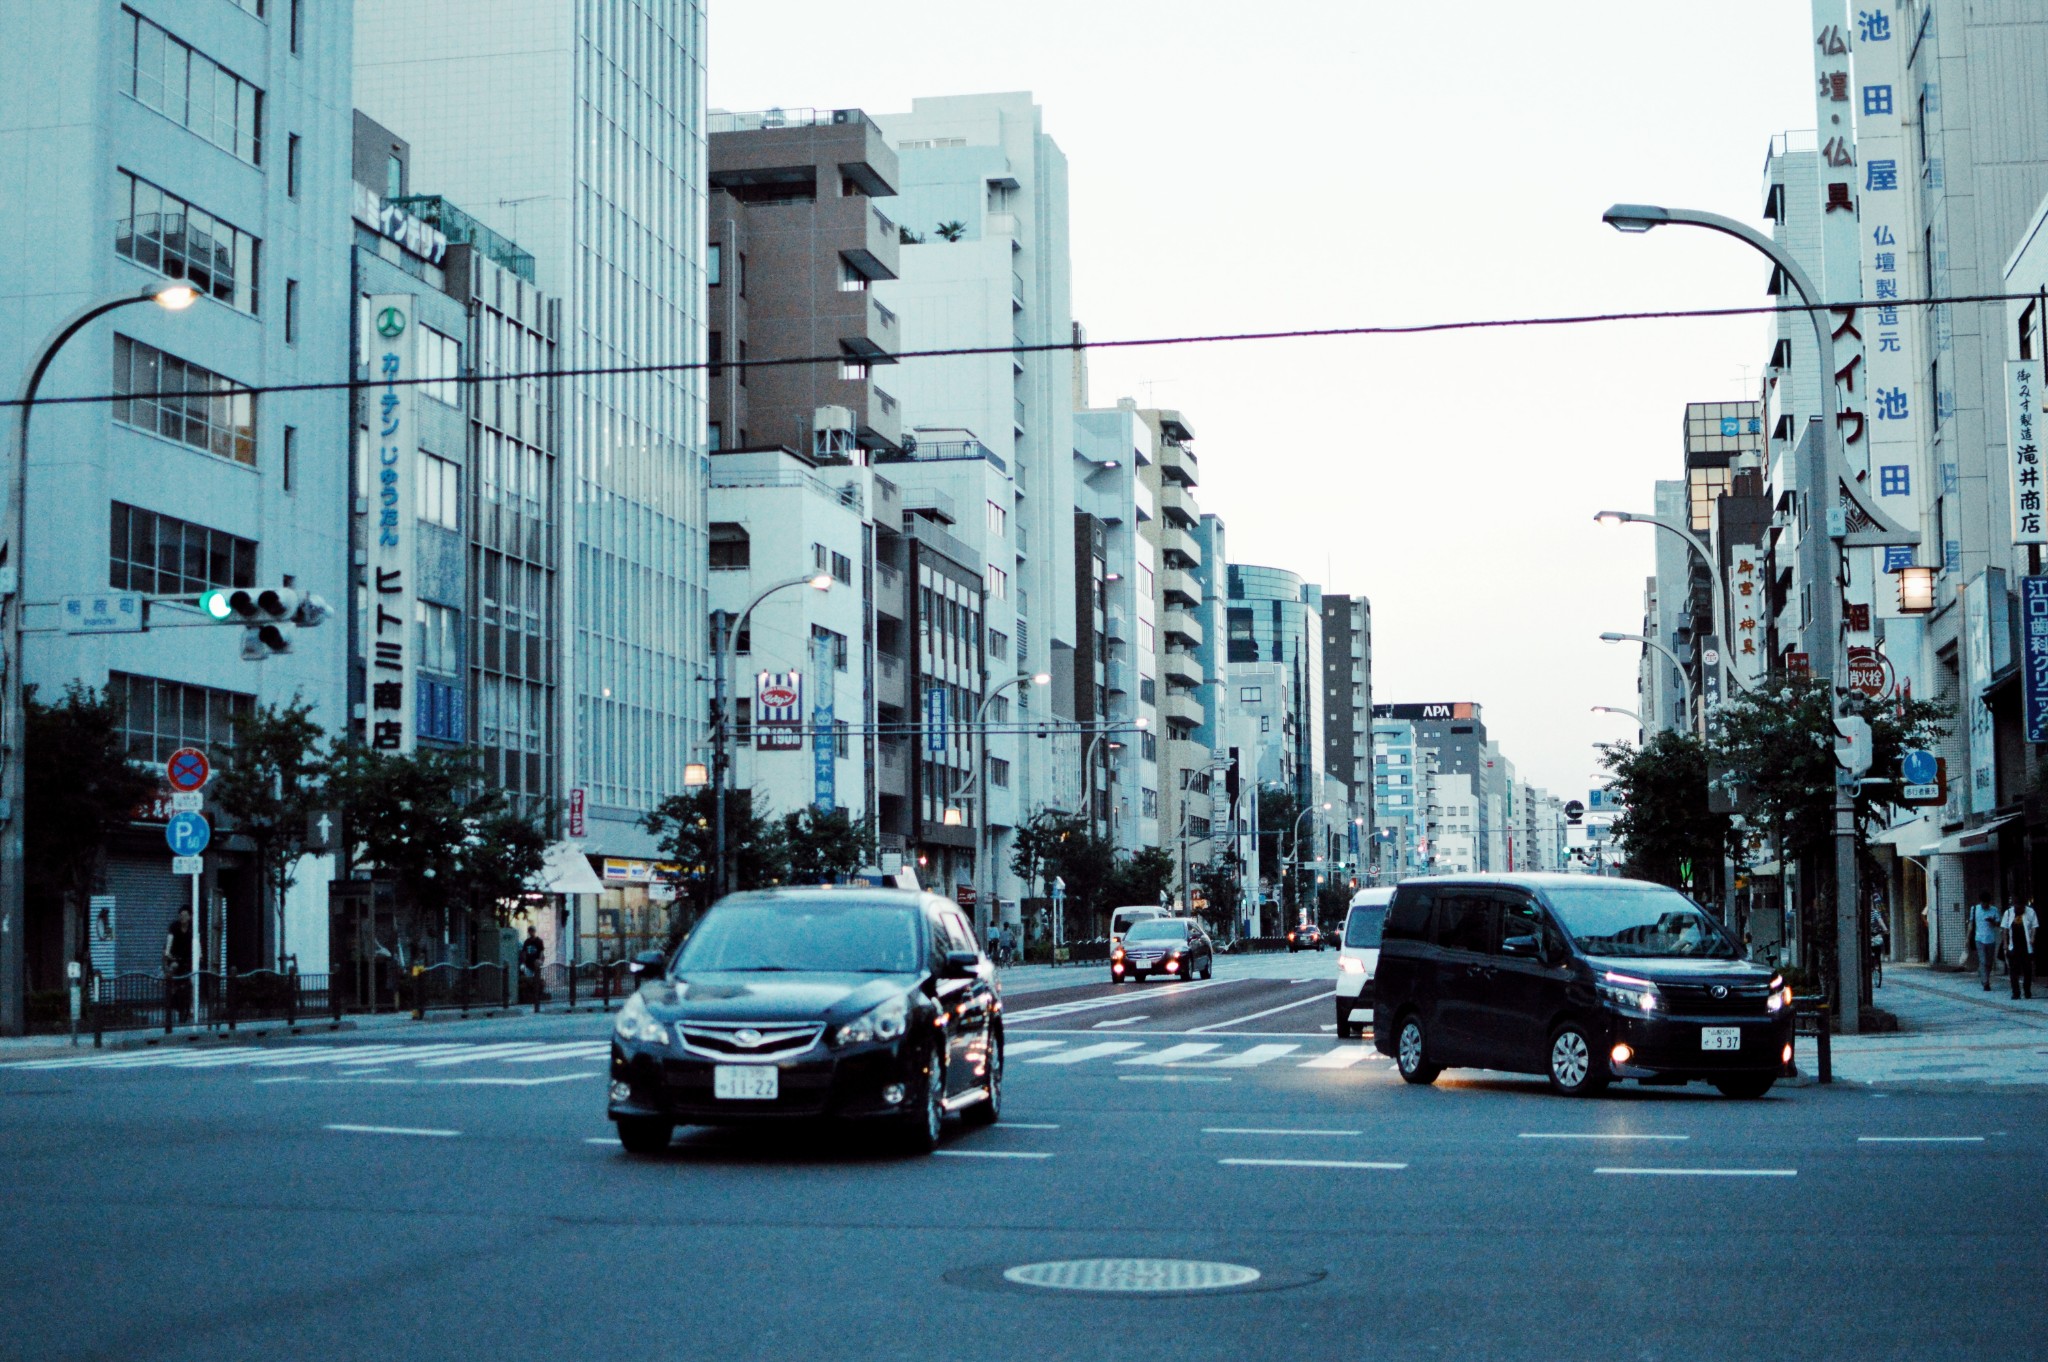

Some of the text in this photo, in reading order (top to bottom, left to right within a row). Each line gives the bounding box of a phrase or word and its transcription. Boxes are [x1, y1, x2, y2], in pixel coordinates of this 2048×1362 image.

[1817, 25, 1853, 214] 仏壇・仏具
[1858, 9, 1897, 191] 池田屋
[1873, 225, 1901, 352] 仏壇製造元
[381, 353, 399, 437] カーテン
[1831, 304, 1867, 483] スイウ
[380, 446, 398, 546] じゅうたん
[2017, 444, 2041, 533] 滝井商店
[1737, 559, 1757, 655] 御宮・神具
[2028, 580, 2048, 729] 江口歯科クリニック
[373, 566, 403, 749] ヒトミ商店
[772, 727, 800, 745] 190m
[1423, 705, 1450, 717] APA
[175, 821, 193, 849] P
